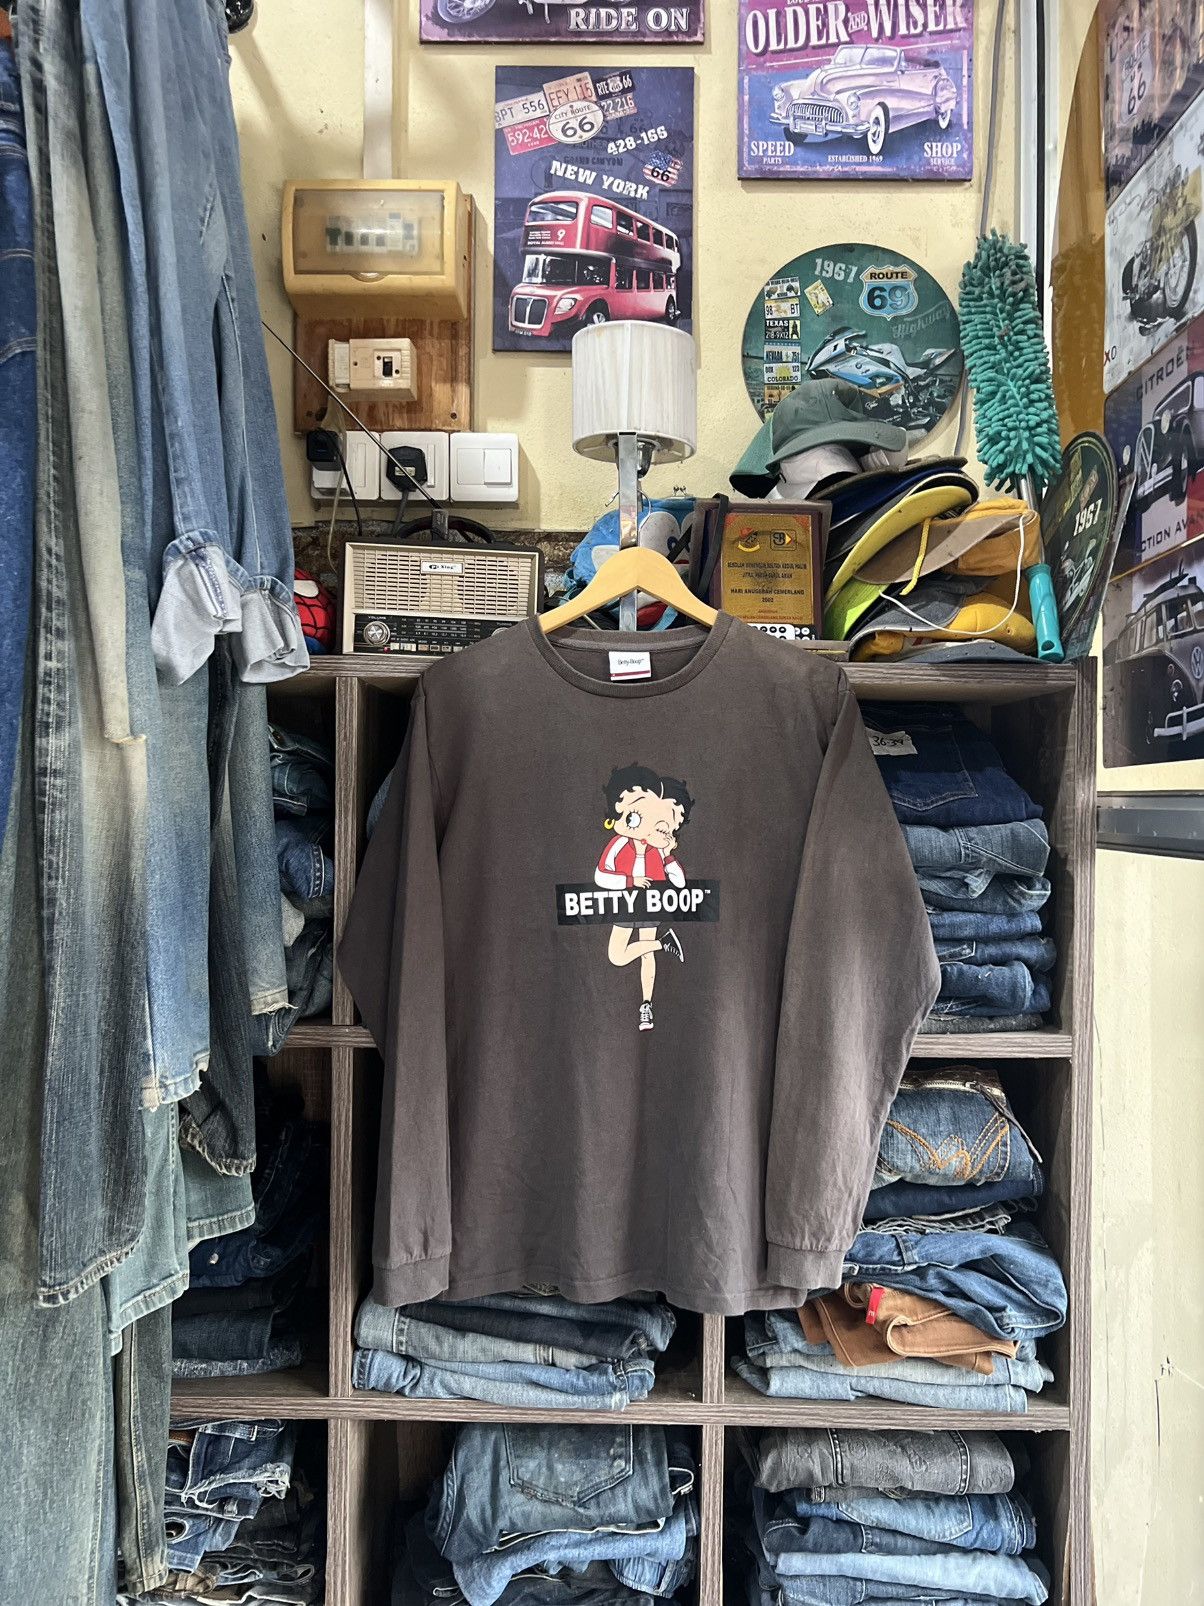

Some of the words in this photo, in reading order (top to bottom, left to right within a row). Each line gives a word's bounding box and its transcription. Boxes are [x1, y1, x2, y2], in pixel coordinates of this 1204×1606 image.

[567, 7, 638, 32] RIDE
[646, 7, 690, 32] ON
[745, 1, 850, 53] OLDER
[867, 0, 966, 39] WISER
[521, 99, 545, 115] 556
[561, 116, 595, 138] 66
[607, 125, 668, 156] 428-166
[750, 140, 795, 156] SPEED
[923, 142, 962, 157] SHOP
[762, 157, 782, 165] PARTS
[550, 160, 597, 186] NEW
[602, 174, 650, 200] YORK
[651, 166, 672, 182] 66
[557, 229, 566, 241] 9
[814, 258, 858, 283] 1967
[869, 271, 908, 281] ROUTE
[867, 286, 911, 311] 69
[767, 375, 798, 383] COLORADO
[564, 890, 639, 916] BETTY
